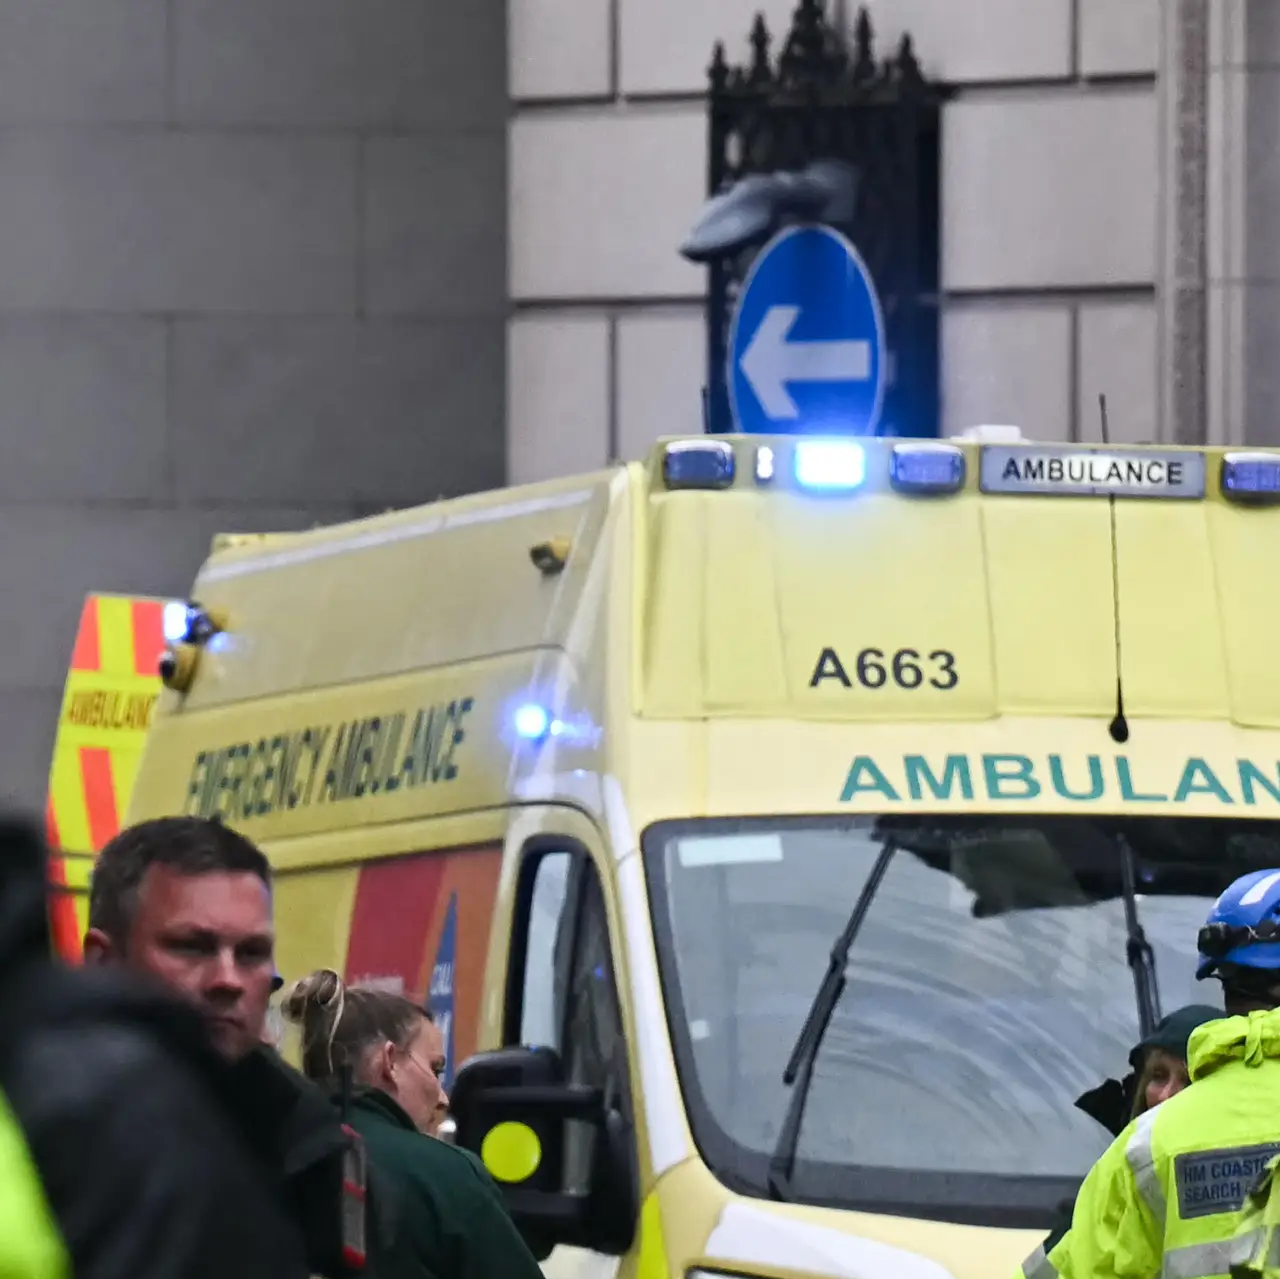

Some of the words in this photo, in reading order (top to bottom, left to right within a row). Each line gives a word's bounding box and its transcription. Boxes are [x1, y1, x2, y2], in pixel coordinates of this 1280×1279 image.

[1001, 457, 1183, 485] AMBULANCE
[810, 647, 958, 689] A663
[184, 724, 332, 822] EMERGENCY
[318, 697, 475, 803] AMBULANCE
[1183, 1164, 1206, 1184] HM
[1185, 1181, 1240, 1203] SEARCH
